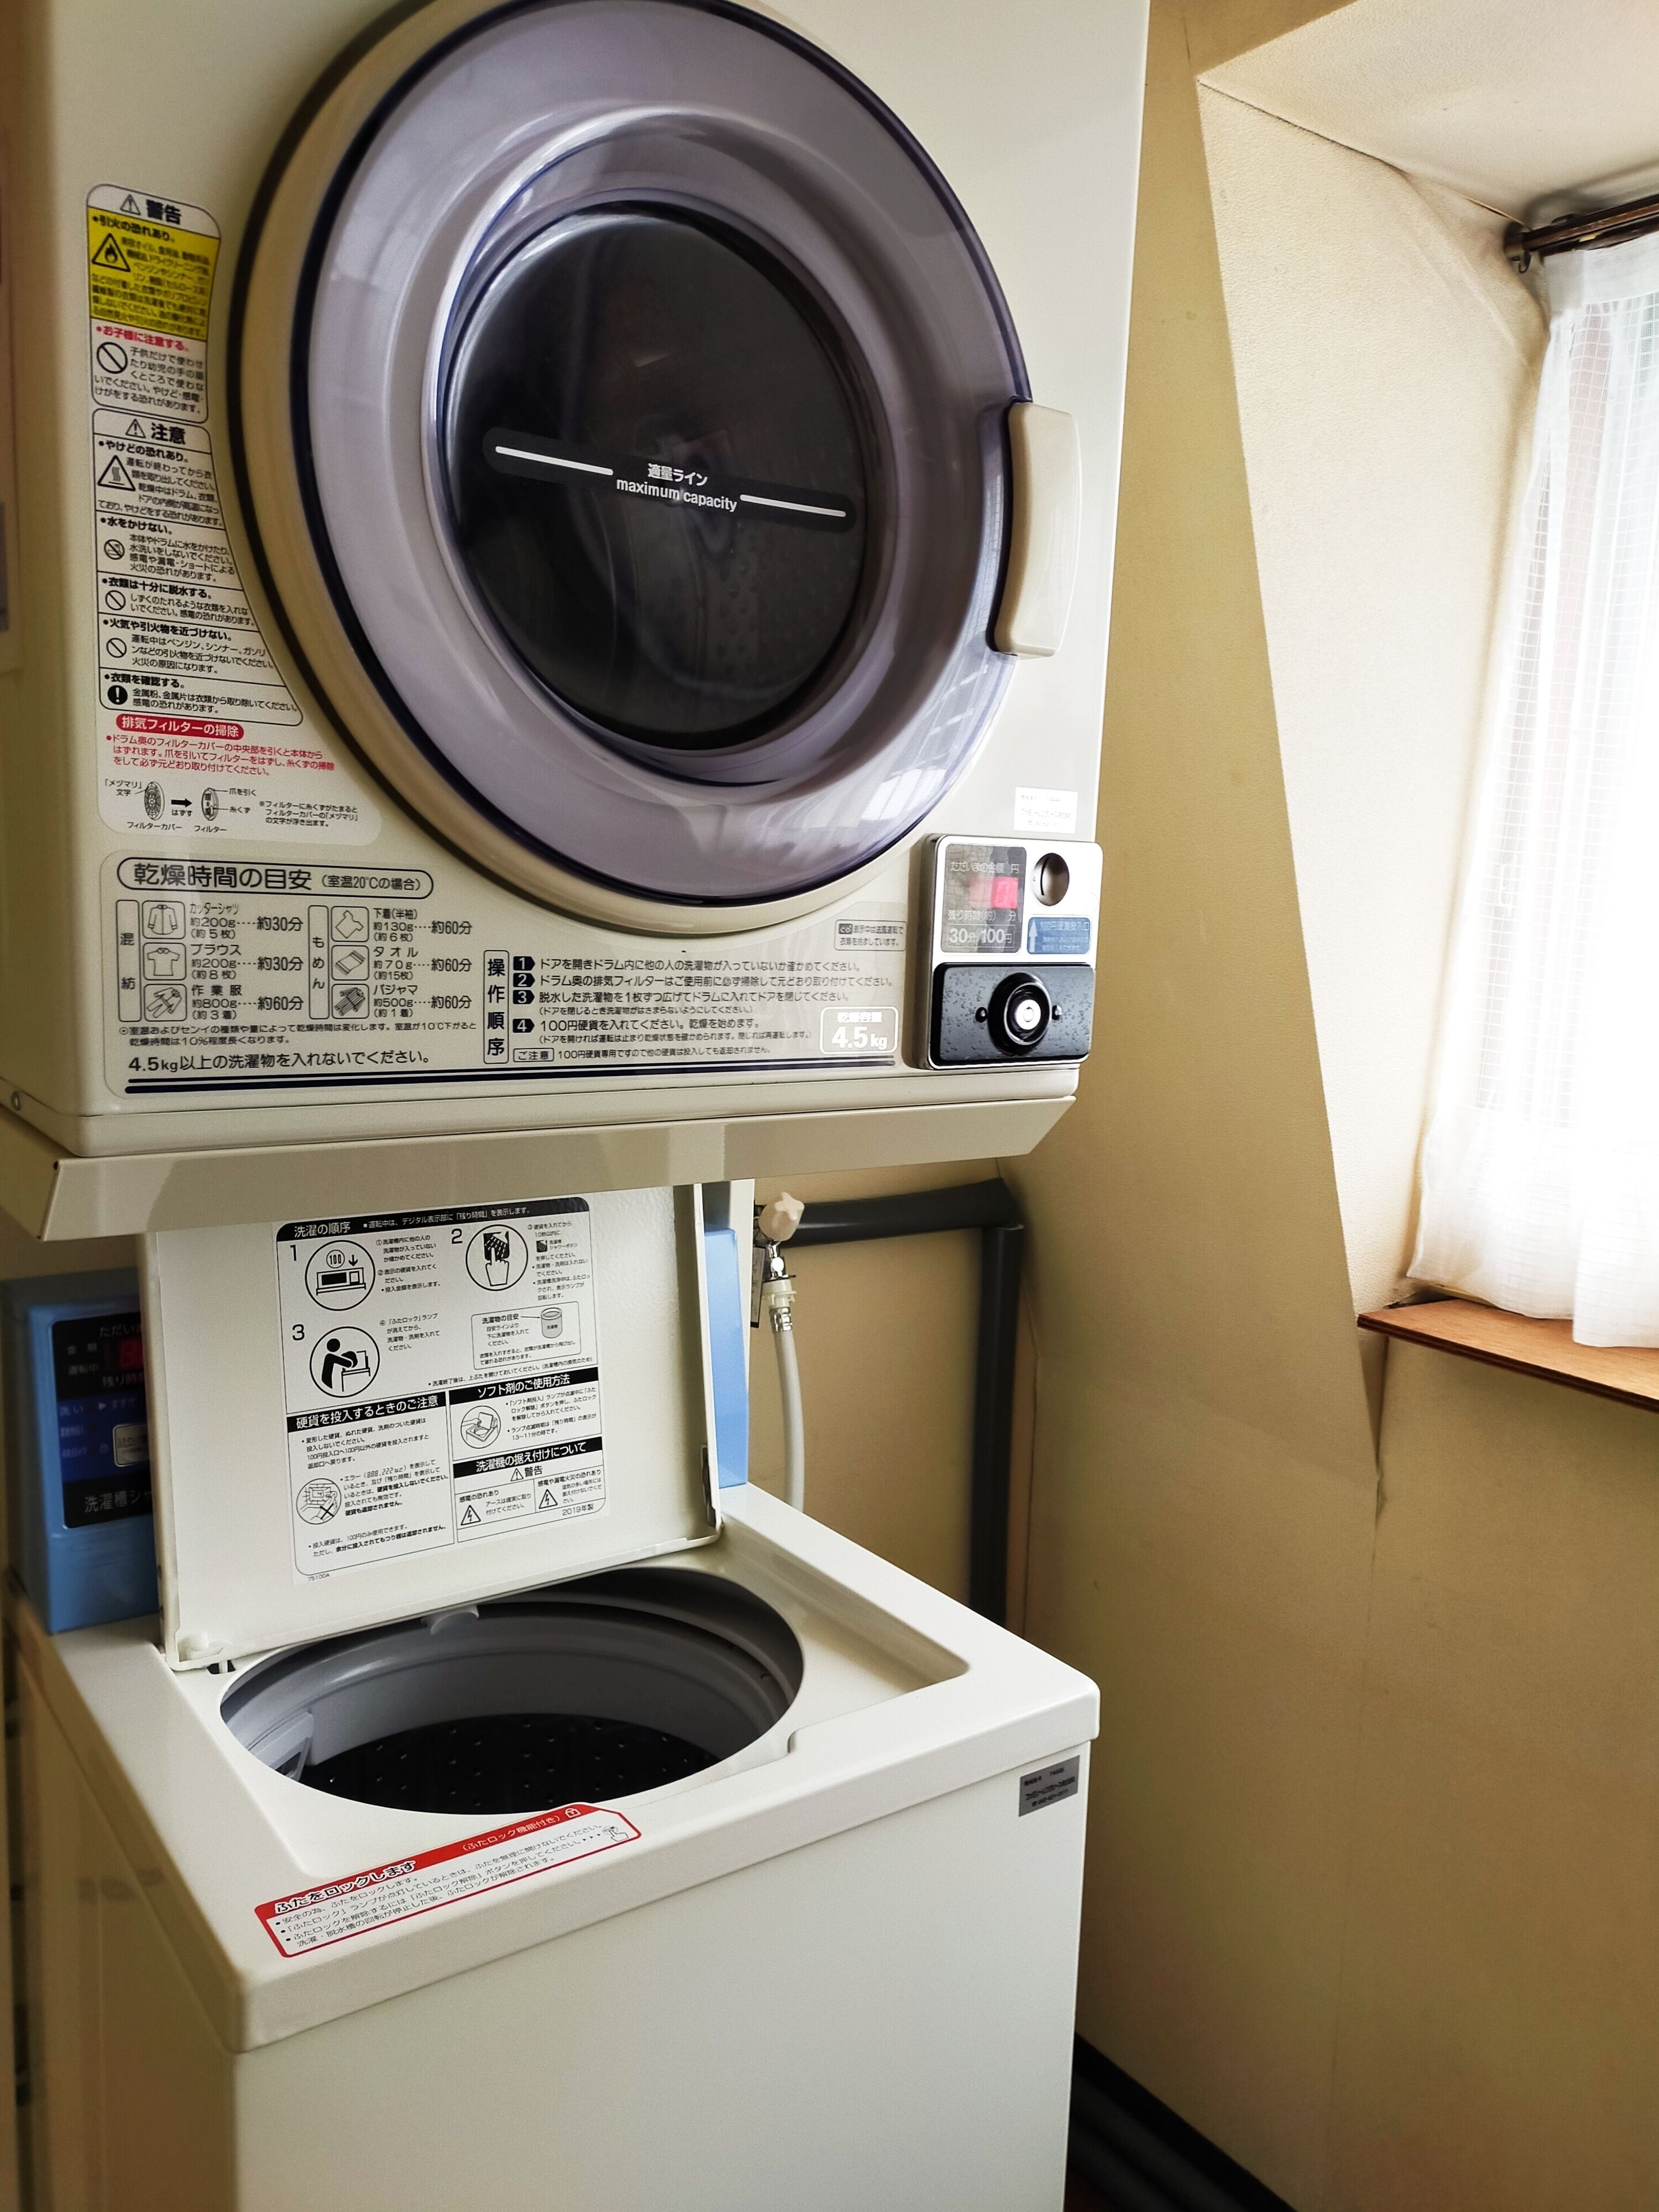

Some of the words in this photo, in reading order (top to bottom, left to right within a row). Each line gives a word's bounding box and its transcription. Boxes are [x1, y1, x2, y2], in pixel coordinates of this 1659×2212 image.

[146, 199, 181, 225] 警告
[151, 423, 185, 445] 注意
[106, 441, 188, 463] やけどの恐れあり。
[647, 463, 707, 486] 適量ライン
[617, 478, 680, 501] maximum
[684, 490, 736, 513] capacity
[108, 517, 172, 535] 水をかけない。
[109, 577, 212, 599] 衣類は十分に脱水する。
[111, 673, 185, 688] 衣類を確認する。
[122, 716, 238, 737] 排気フィルターの掃除
[229, 788, 256, 796] 爪を引く
[1011, 864, 1019, 873] 円
[134, 863, 312, 890] 乾燥時間の目安
[257, 916, 303, 931] 約30分
[431, 921, 472, 934] 約60分
[191, 944, 241, 956] ブラウス
[257, 957, 303, 971] 約30分
[312, 937, 324, 989] もめん
[431, 959, 472, 971] 約60分
[518, 958, 526, 969] 1
[518, 975, 527, 986] 2
[257, 997, 304, 1010] 約60分
[431, 996, 472, 1009] 約60分
[518, 991, 527, 1003] 3
[488, 959, 505, 1055] 操作順序
[517, 1020, 527, 1031] 4
[518, 1051, 548, 1060] ご注意
[294, 1222, 350, 1238] 洗濯の順序
[452, 1229, 463, 1244] 2
[290, 1245, 297, 1261] 1
[482, 1314, 518, 1324] 洗濯物の目安
[292, 1324, 305, 1340] 3
[479, 1373, 570, 1397] ソフト剤のご使用方法
[476, 1442, 586, 1472] 洗濯機の据え付けについて
[525, 1465, 542, 1478] 警告
[563, 1503, 593, 1515] 2019年製
[275, 1861, 415, 1914] ふたをロックします
